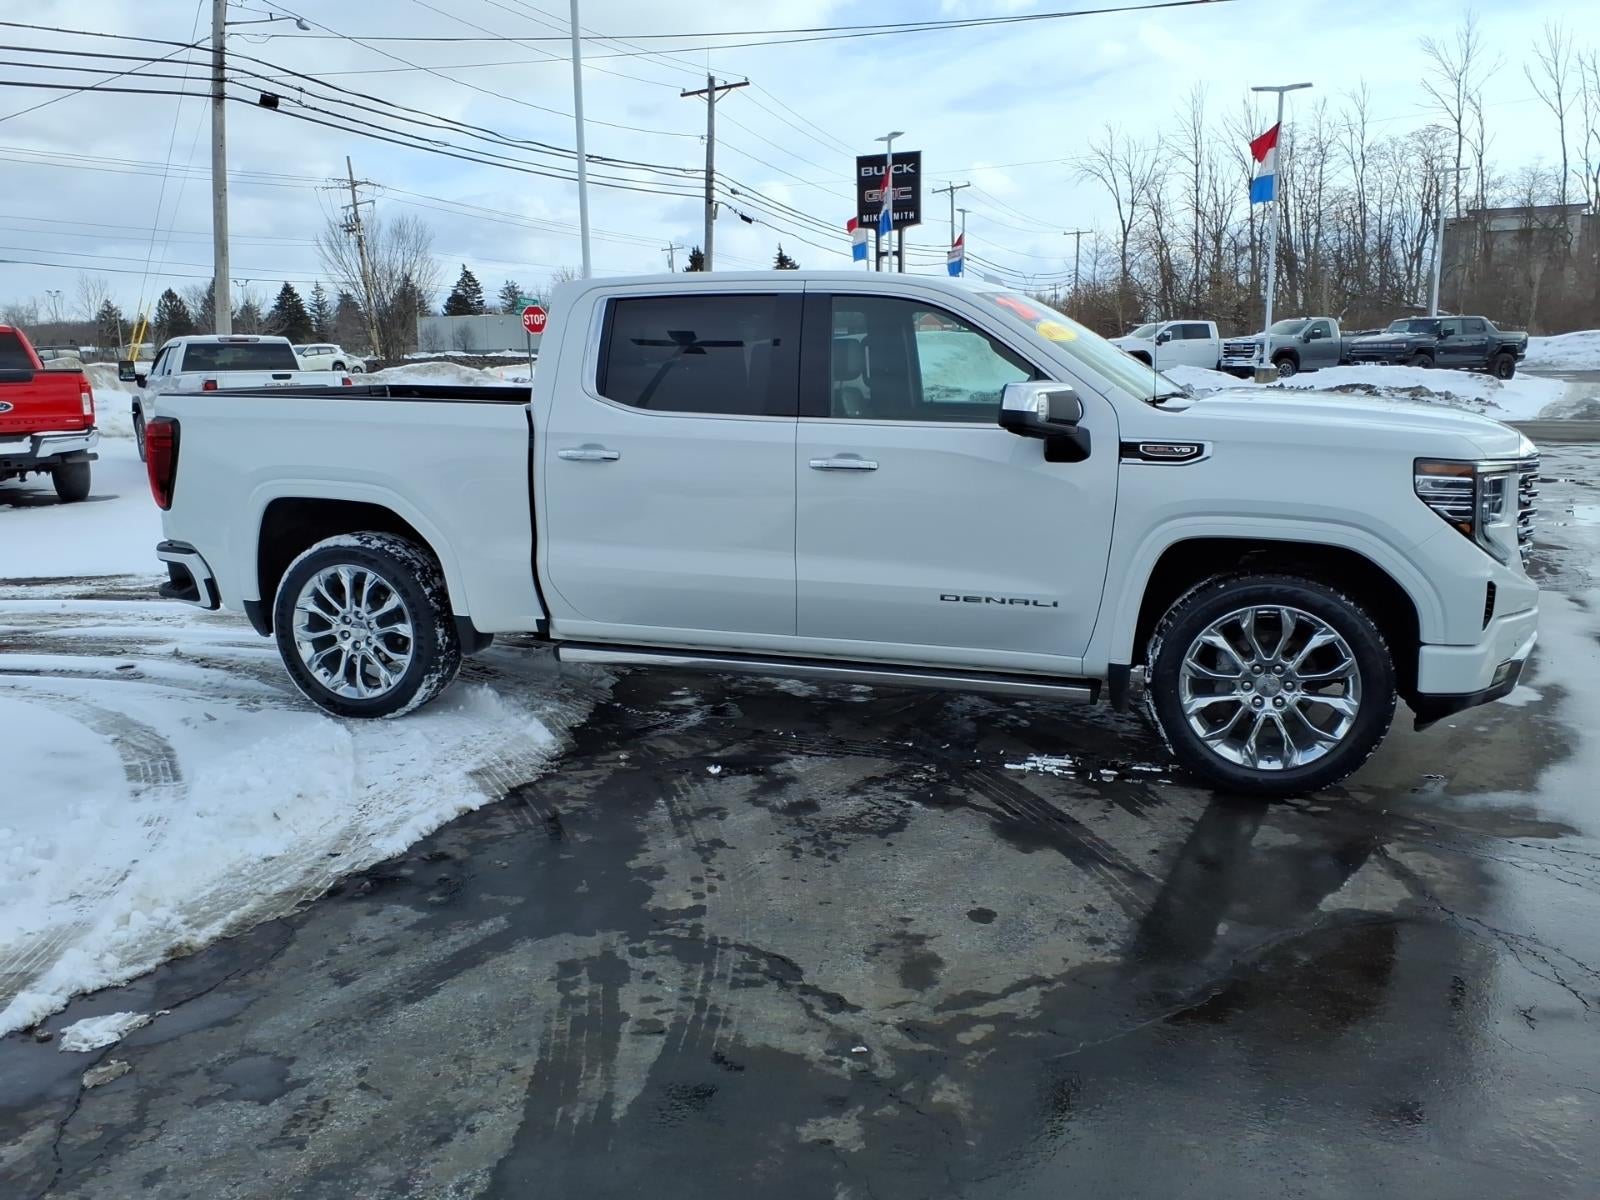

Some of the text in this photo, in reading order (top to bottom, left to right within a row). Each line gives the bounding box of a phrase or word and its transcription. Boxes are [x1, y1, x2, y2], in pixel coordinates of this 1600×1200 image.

[861, 163, 916, 177] BUCK
[862, 211, 915, 223] MIK MITH
[524, 314, 545, 325] STOP
[940, 594, 1058, 608] DENALI
